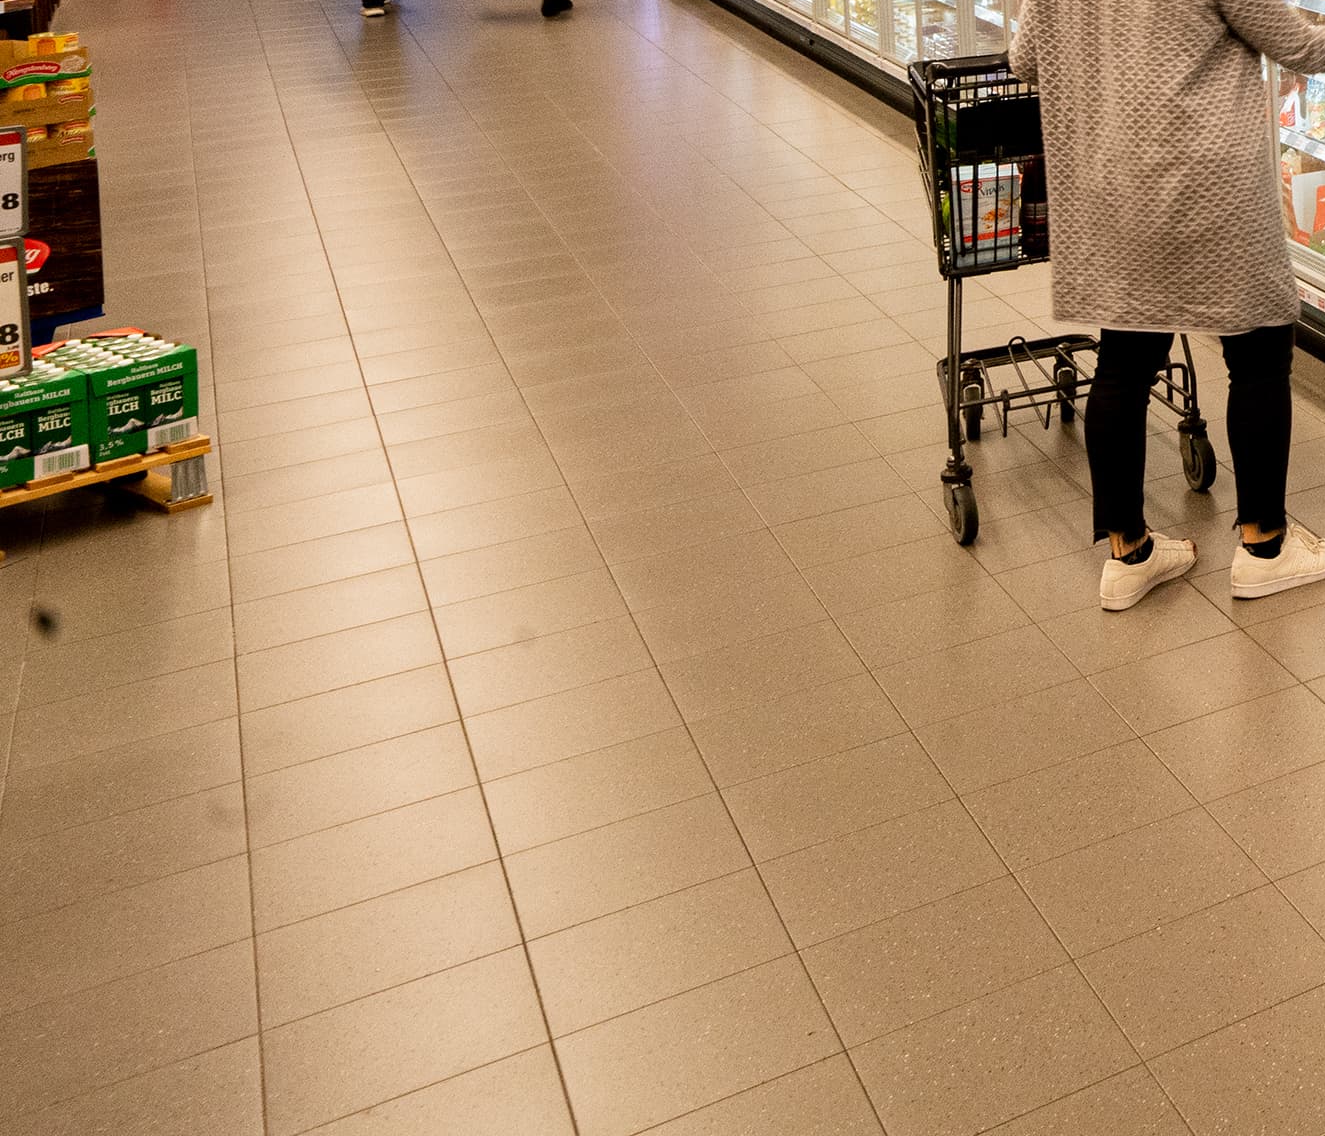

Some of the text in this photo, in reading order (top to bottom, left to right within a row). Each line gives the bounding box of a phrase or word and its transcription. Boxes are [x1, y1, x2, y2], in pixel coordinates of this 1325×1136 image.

[2, 194, 19, 209] 8
[107, 362, 183, 387] Bergbauern MILCH
[42, 389, 70, 400] MILCH
[151, 392, 182, 405] MILC
[109, 401, 139, 415] ILCH
[38, 417, 71, 432] MILC
